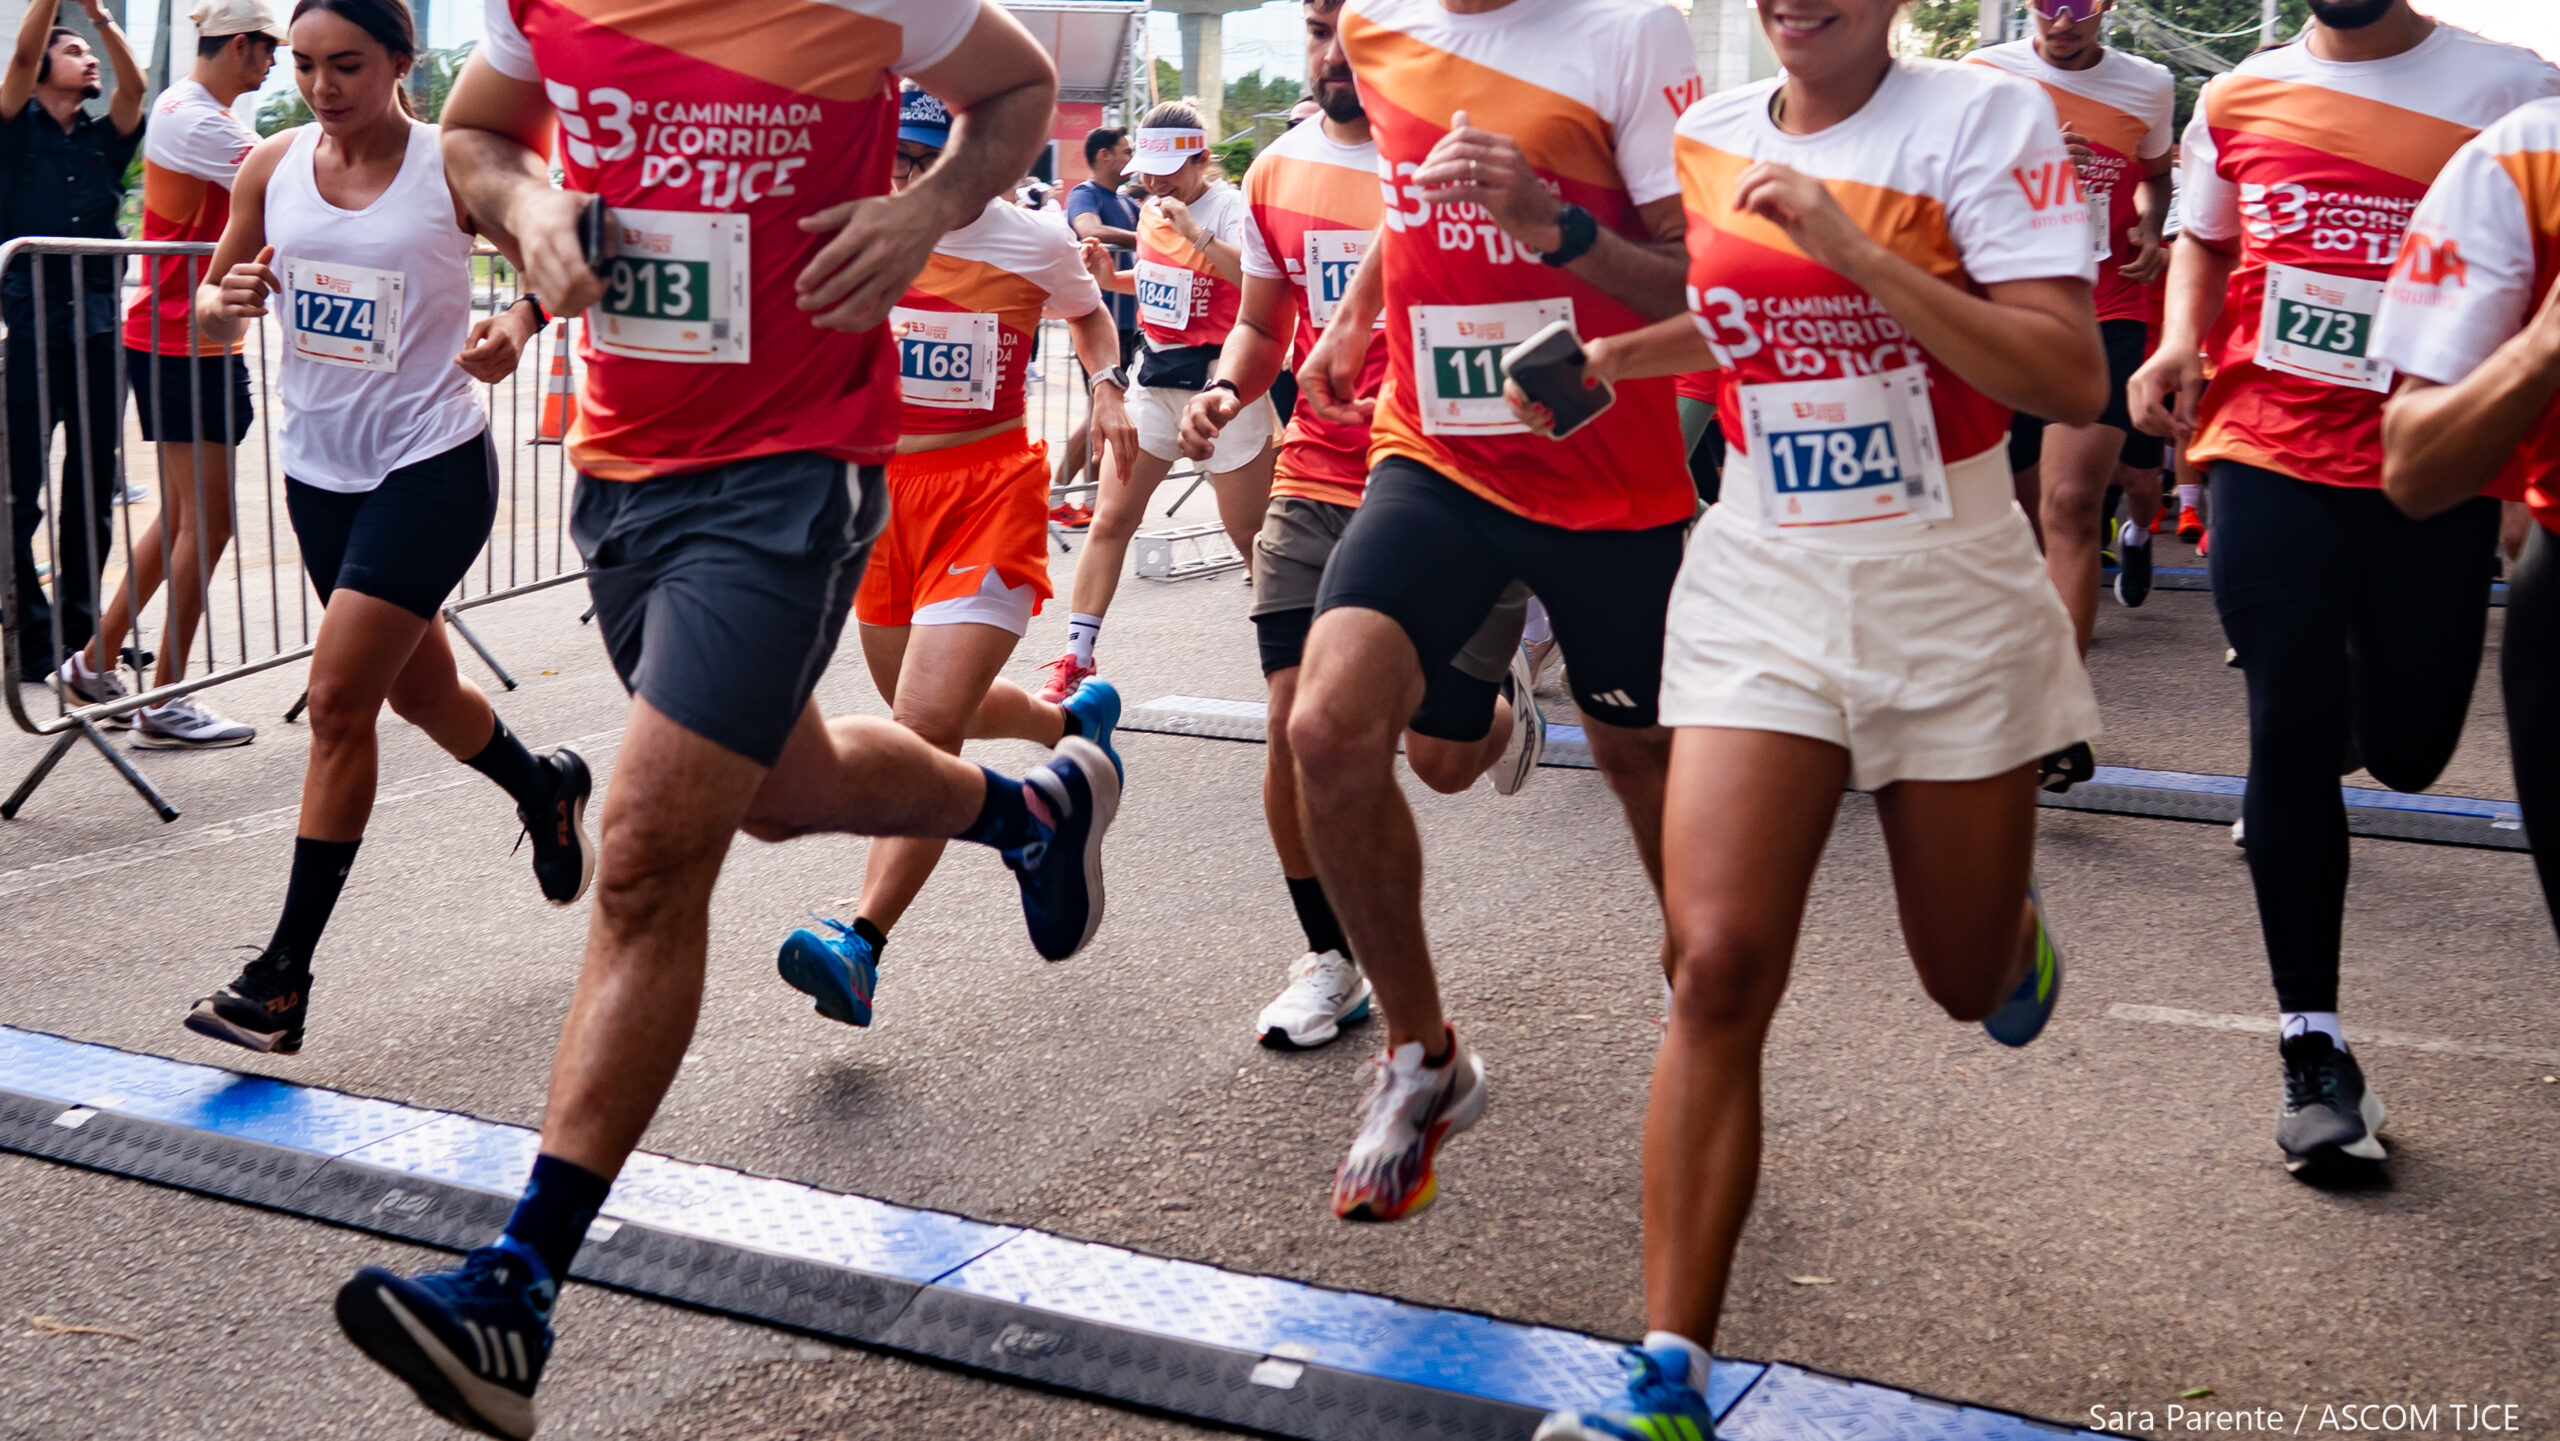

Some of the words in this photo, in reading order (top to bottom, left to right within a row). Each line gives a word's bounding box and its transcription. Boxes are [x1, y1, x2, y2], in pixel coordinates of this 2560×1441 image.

[654, 101, 822, 126] CAMINHADA
[644, 123, 812, 156] /CORRIDA
[640, 155, 692, 188] DO
[697, 157, 806, 208] TJCE
[1438, 222, 1475, 250] DO
[2312, 228, 2358, 250] DO
[611, 259, 693, 317] 913
[1140, 280, 1176, 309] 1844
[297, 293, 373, 338] 1274
[2286, 304, 2357, 351] 273
[1449, 346, 1518, 395] 11
[1775, 347, 1826, 377] DO
[1773, 427, 1899, 488] 1784
[265, 991, 298, 1013] FILA
